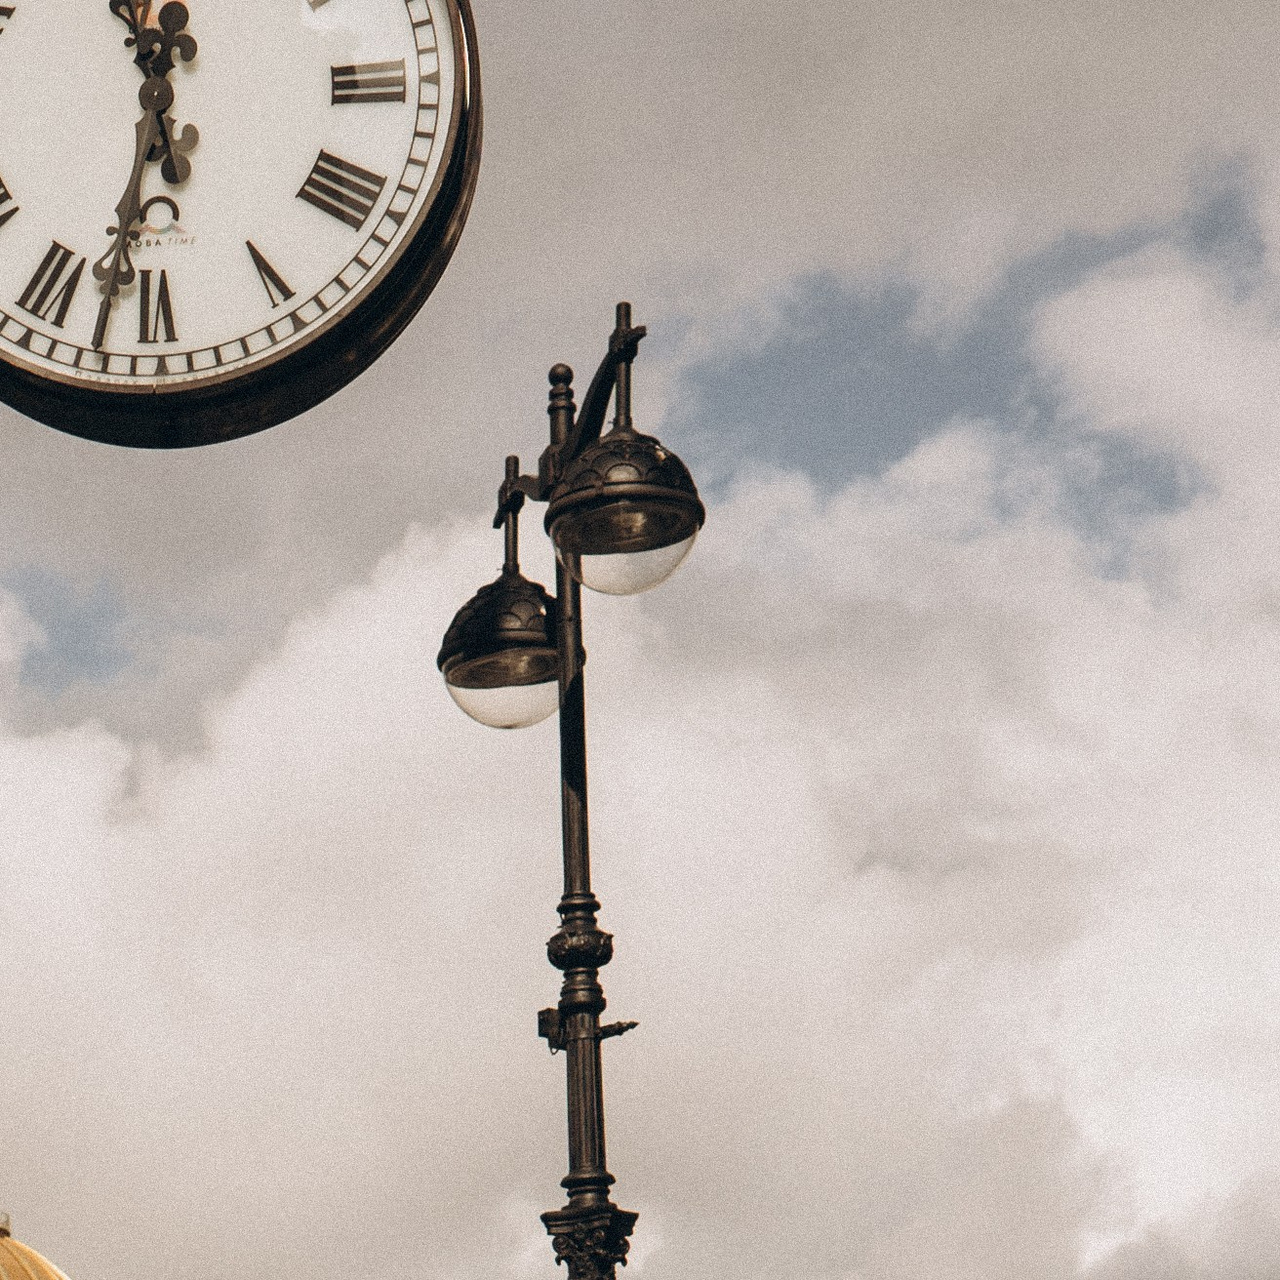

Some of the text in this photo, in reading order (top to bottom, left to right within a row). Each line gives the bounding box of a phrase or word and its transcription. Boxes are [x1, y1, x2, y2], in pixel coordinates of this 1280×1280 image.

[330, 58, 406, 105] III
[295, 148, 388, 232] IIII
[168, 236, 198, 246] TIME
[245, 239, 296, 309] V
